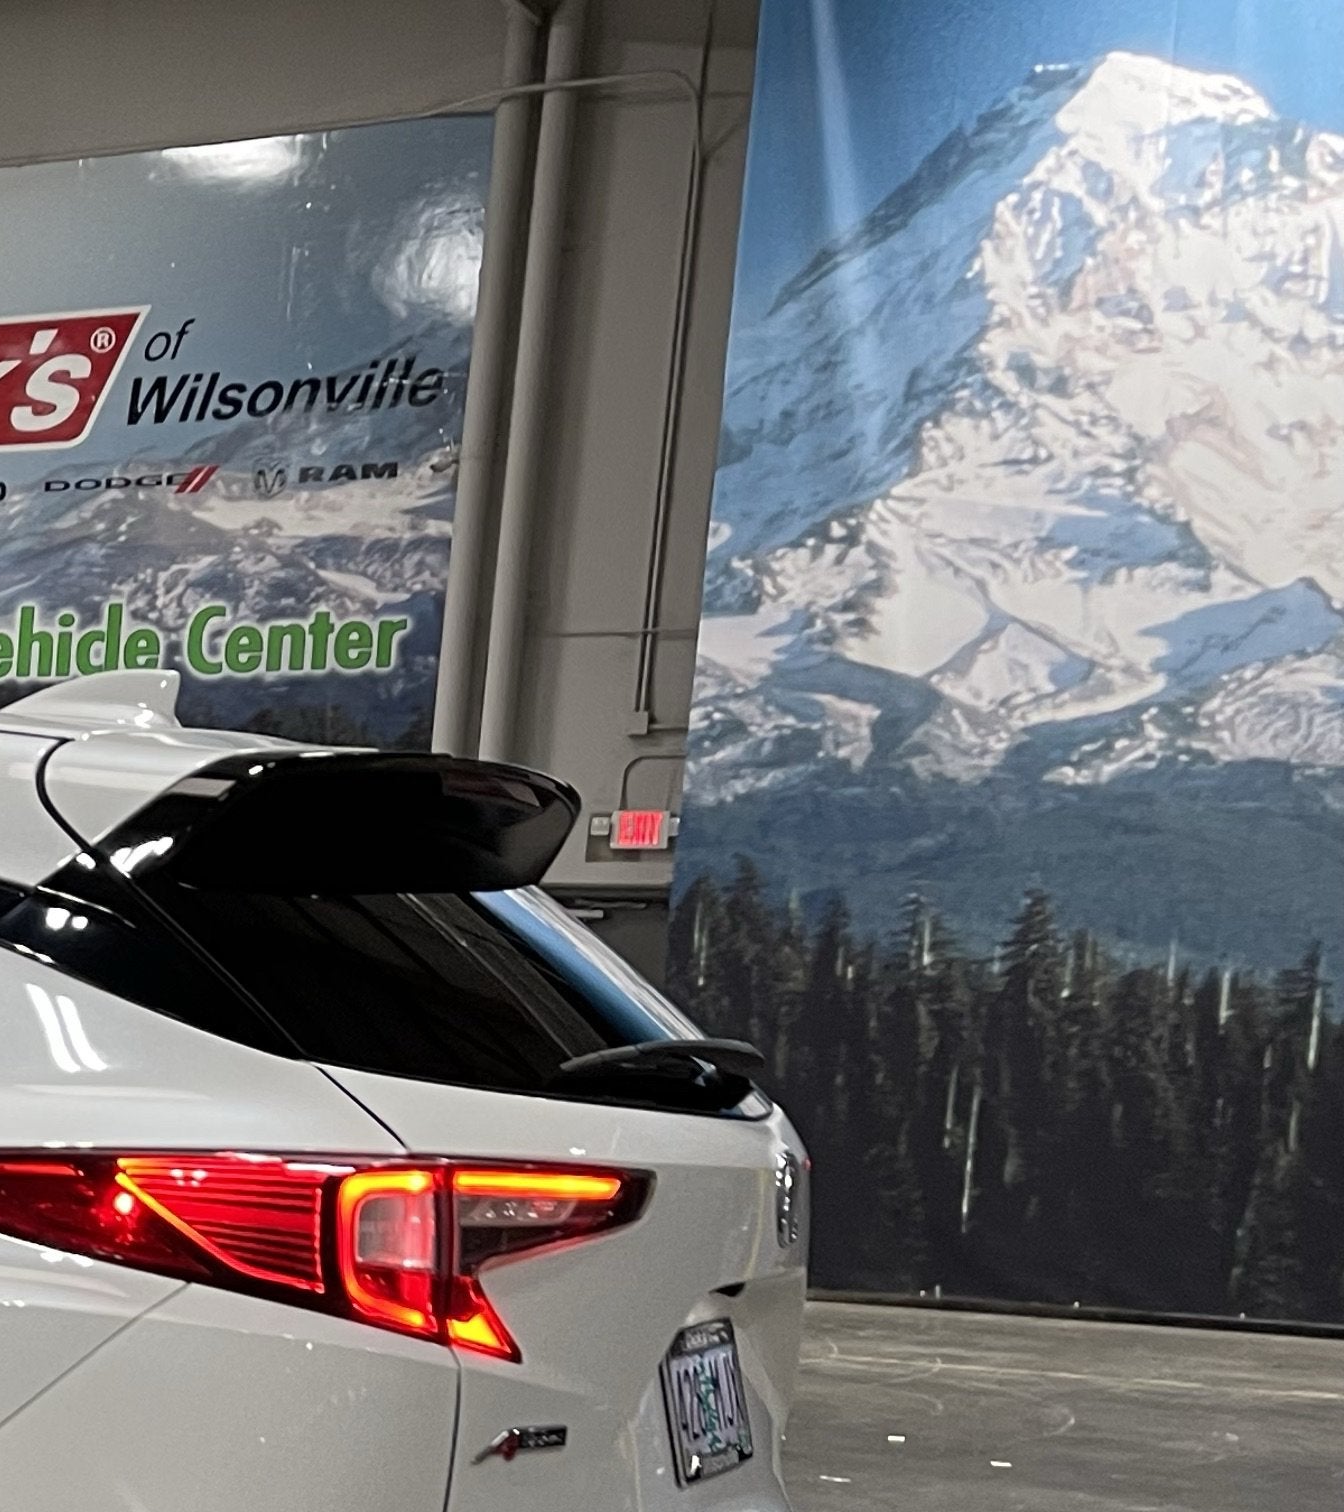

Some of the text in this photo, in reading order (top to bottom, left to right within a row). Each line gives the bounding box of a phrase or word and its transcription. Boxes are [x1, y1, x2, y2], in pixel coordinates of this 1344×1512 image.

[144, 318, 195, 362] of
[127, 356, 444, 425] Wilsonville
[298, 462, 399, 484] RAM
[187, 605, 407, 675] Center
